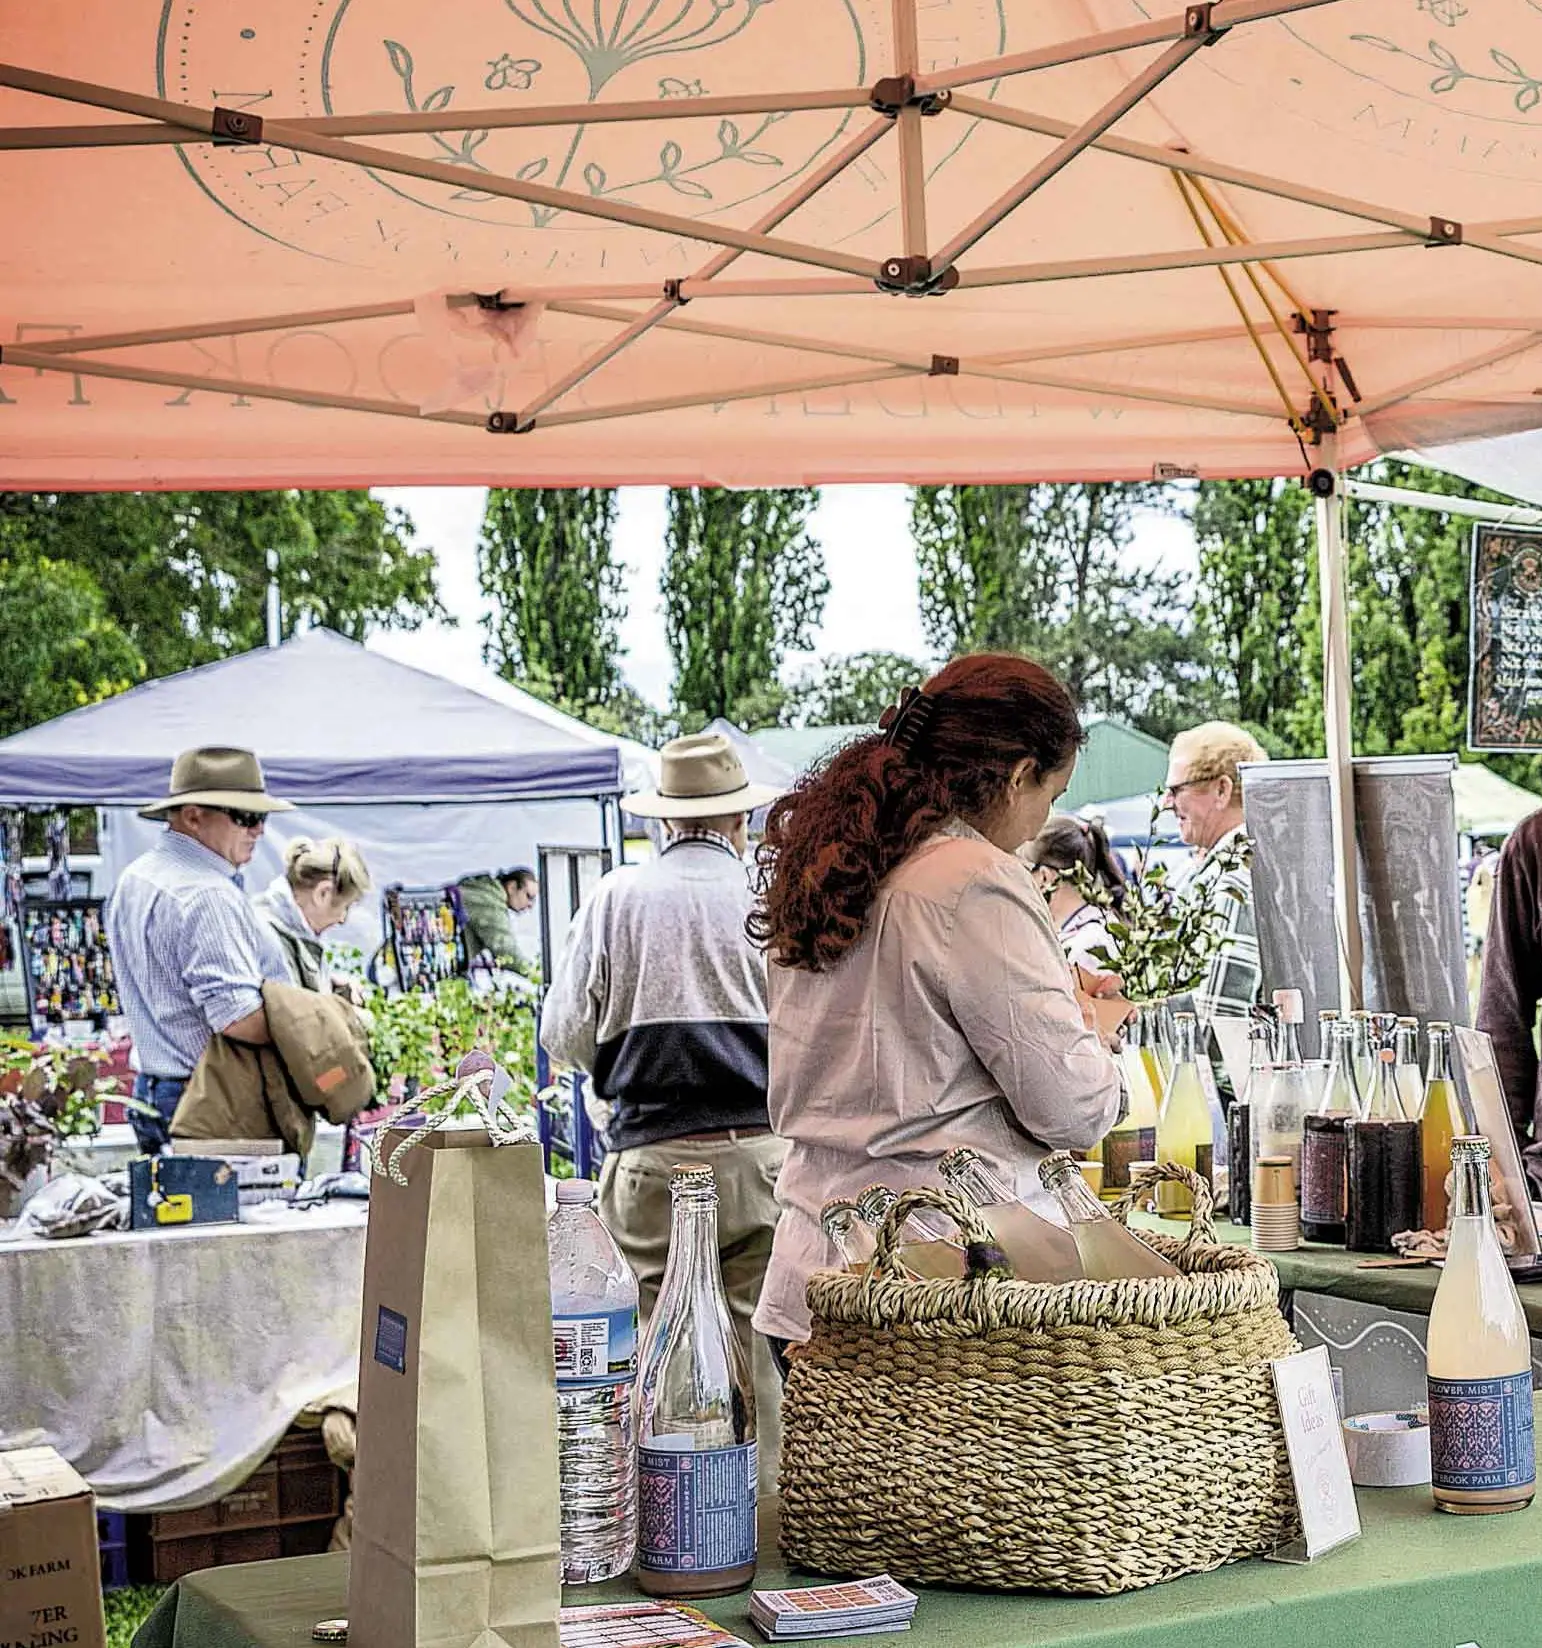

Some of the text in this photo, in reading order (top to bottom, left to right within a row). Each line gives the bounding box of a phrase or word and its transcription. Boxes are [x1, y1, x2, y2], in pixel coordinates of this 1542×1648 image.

[1468, 1384, 1495, 1395] MIST
[647, 1456, 671, 1469] MIST
[1471, 1473, 1502, 1485] FARM
[29, 1559, 71, 1577] FARM
